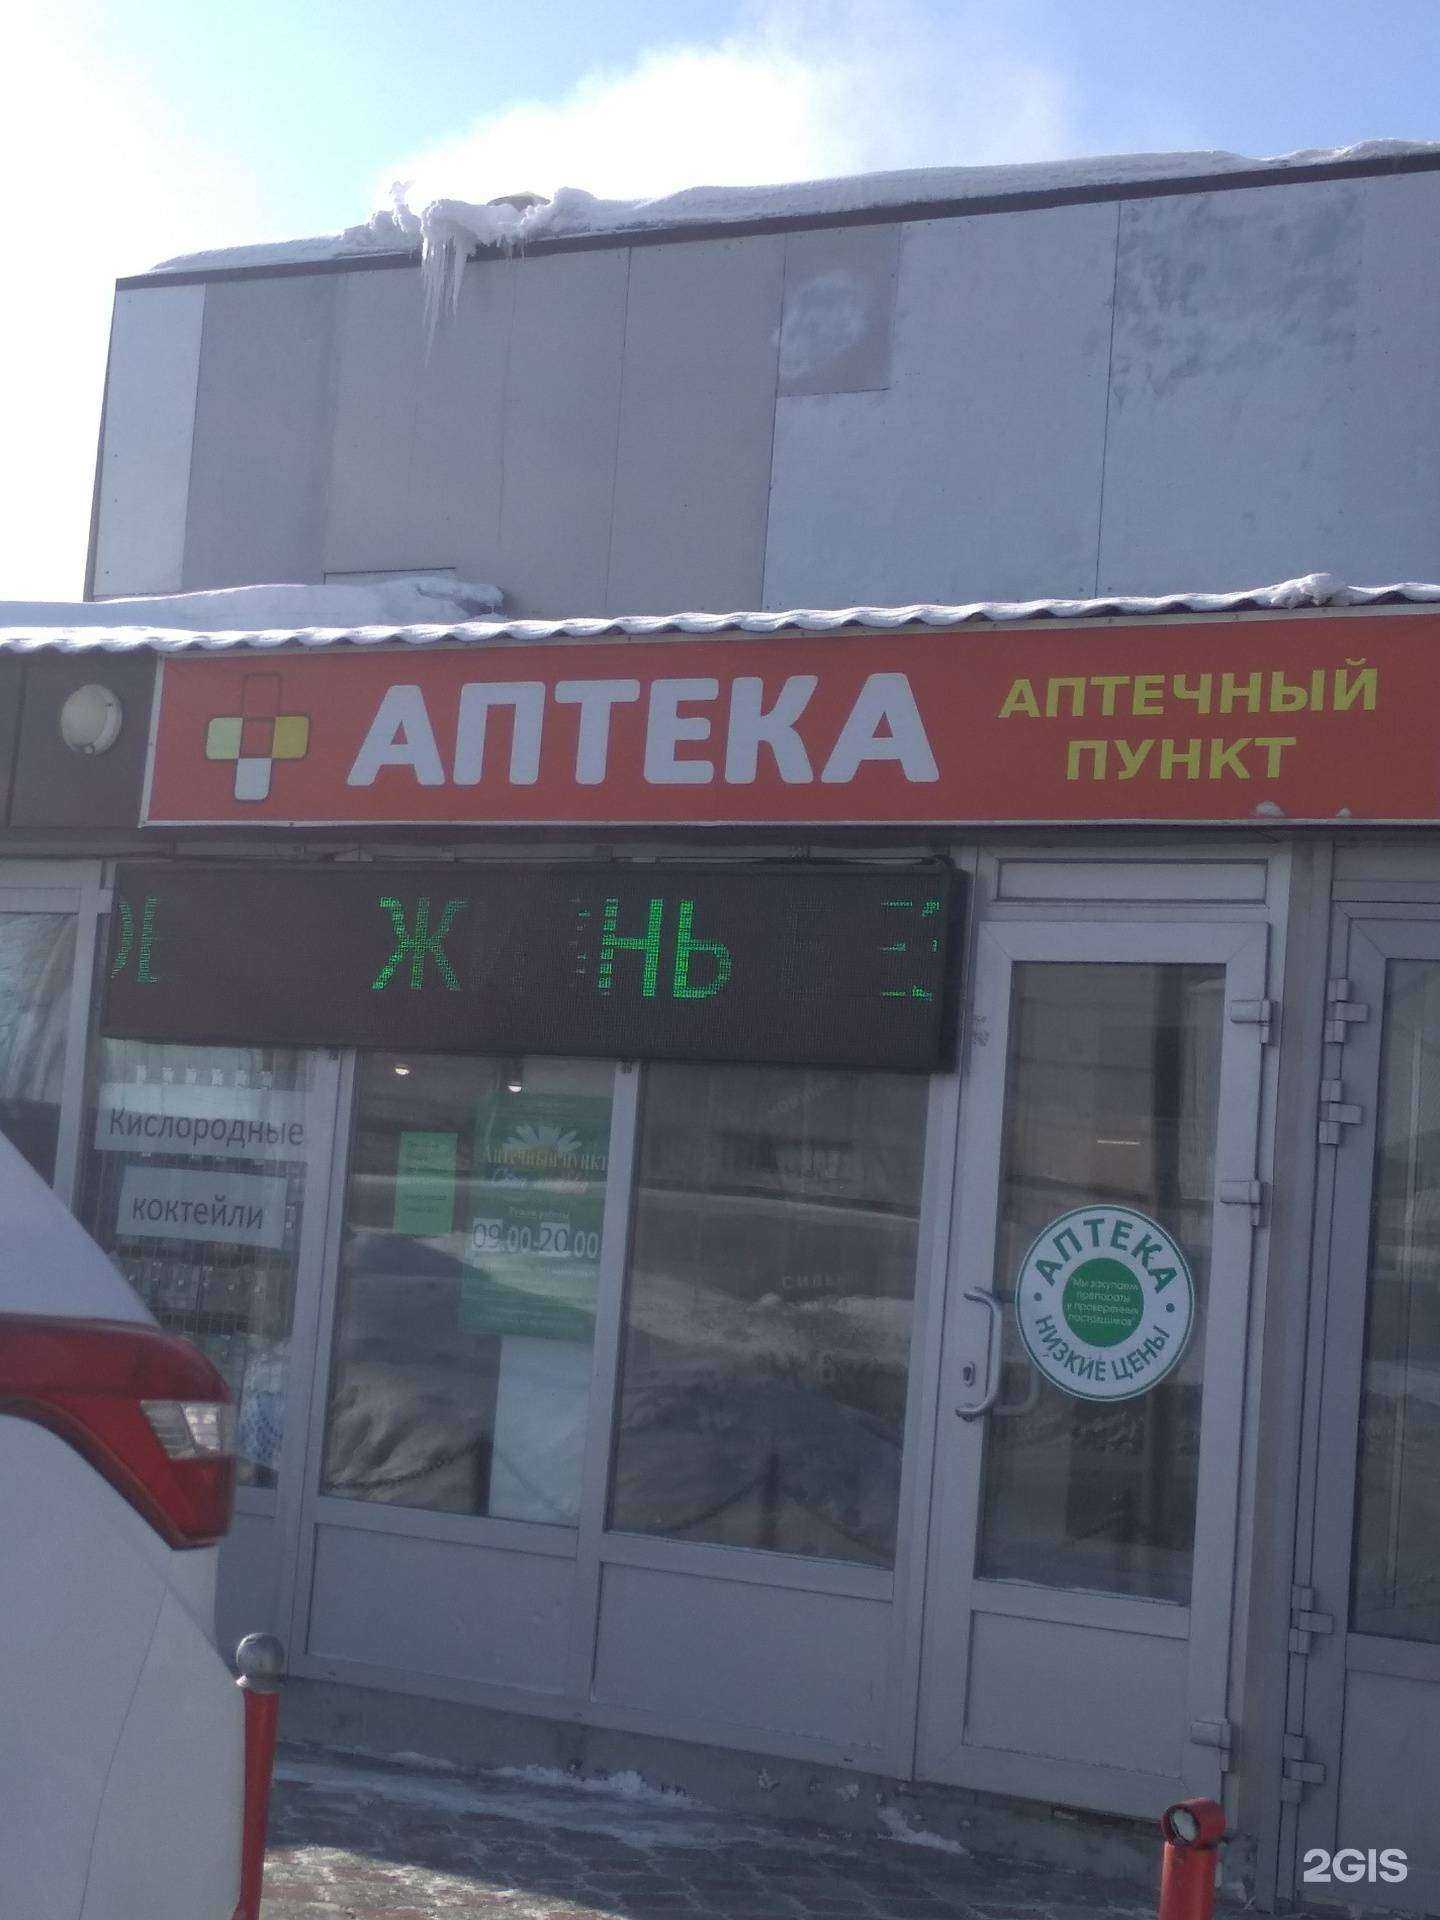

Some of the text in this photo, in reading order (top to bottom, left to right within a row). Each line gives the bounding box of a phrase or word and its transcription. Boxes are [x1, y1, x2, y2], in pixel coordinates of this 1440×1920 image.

[998, 656, 1379, 718] АПТЕЧНЫЙ
[346, 672, 941, 787] АПТЕКА
[1066, 736, 1297, 781] ПУНКТ
[108, 1107, 305, 1149] Кислородные
[131, 1194, 265, 1230] коктейли
[1035, 1218, 1178, 1294] АПТЕКА
[1035, 1315, 1171, 1382] НИЗКИЕ ЦЕНЫ
